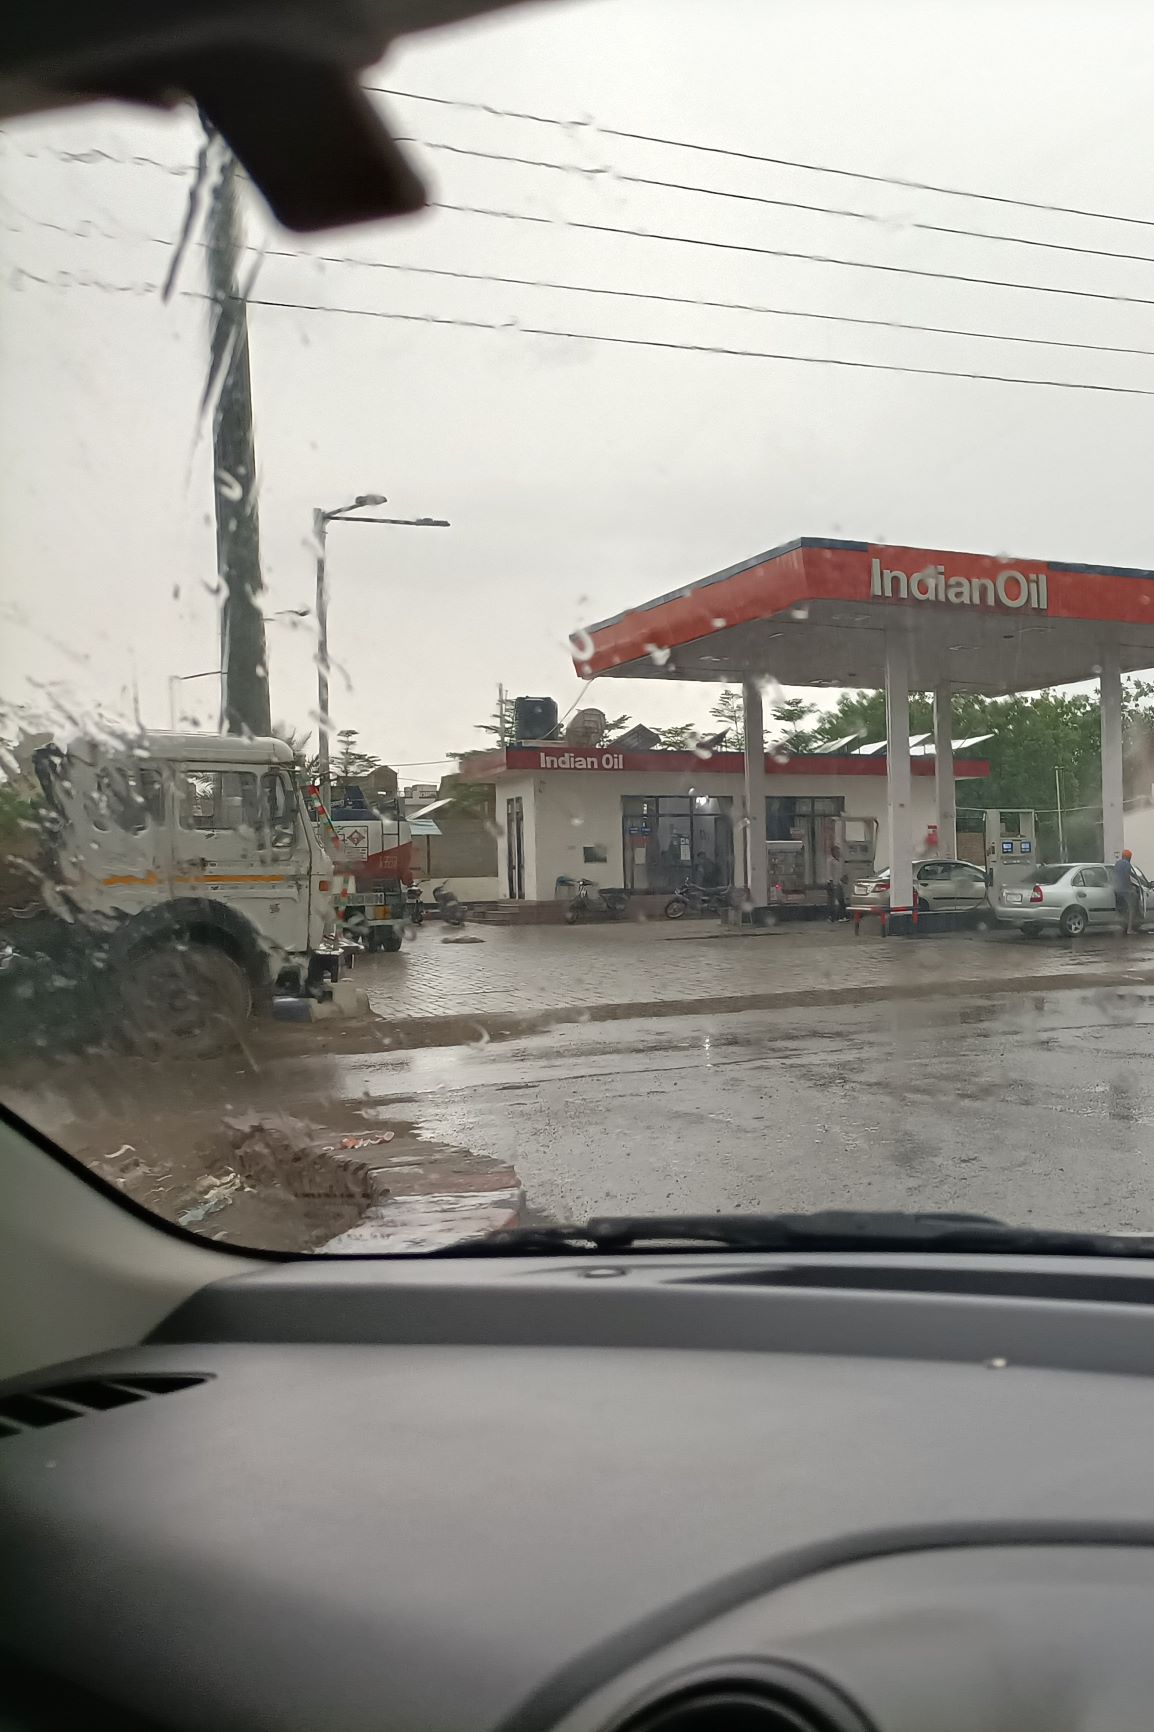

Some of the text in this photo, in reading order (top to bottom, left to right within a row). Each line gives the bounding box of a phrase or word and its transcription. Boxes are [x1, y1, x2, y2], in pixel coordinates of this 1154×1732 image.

[871, 558, 1048, 609] IndianOil
[540, 752, 624, 769] Indian Oil
